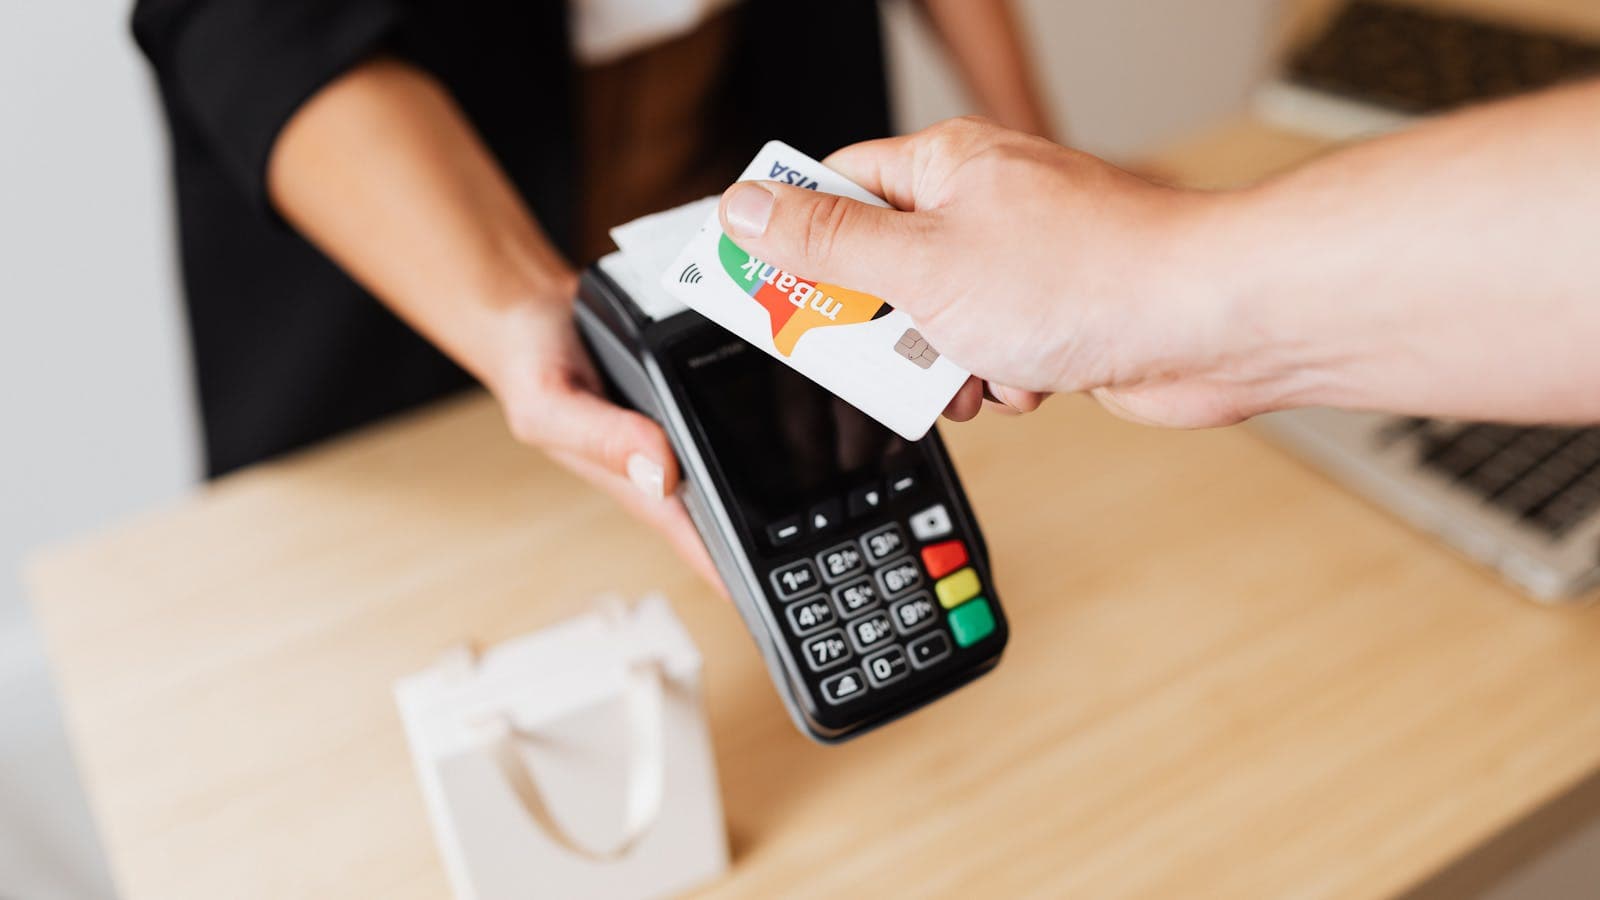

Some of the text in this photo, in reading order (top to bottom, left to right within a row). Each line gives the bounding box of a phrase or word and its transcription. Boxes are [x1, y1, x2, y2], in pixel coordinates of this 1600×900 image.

[740, 256, 844, 321] mBank
[782, 571, 798, 591] 1
[827, 553, 844, 575] 2
[870, 535, 888, 557] 3
[798, 606, 816, 626] 4
[812, 641, 827, 663] 7
[858, 622, 876, 644] 8
[900, 604, 917, 626] 9
[872, 657, 891, 680] 0
